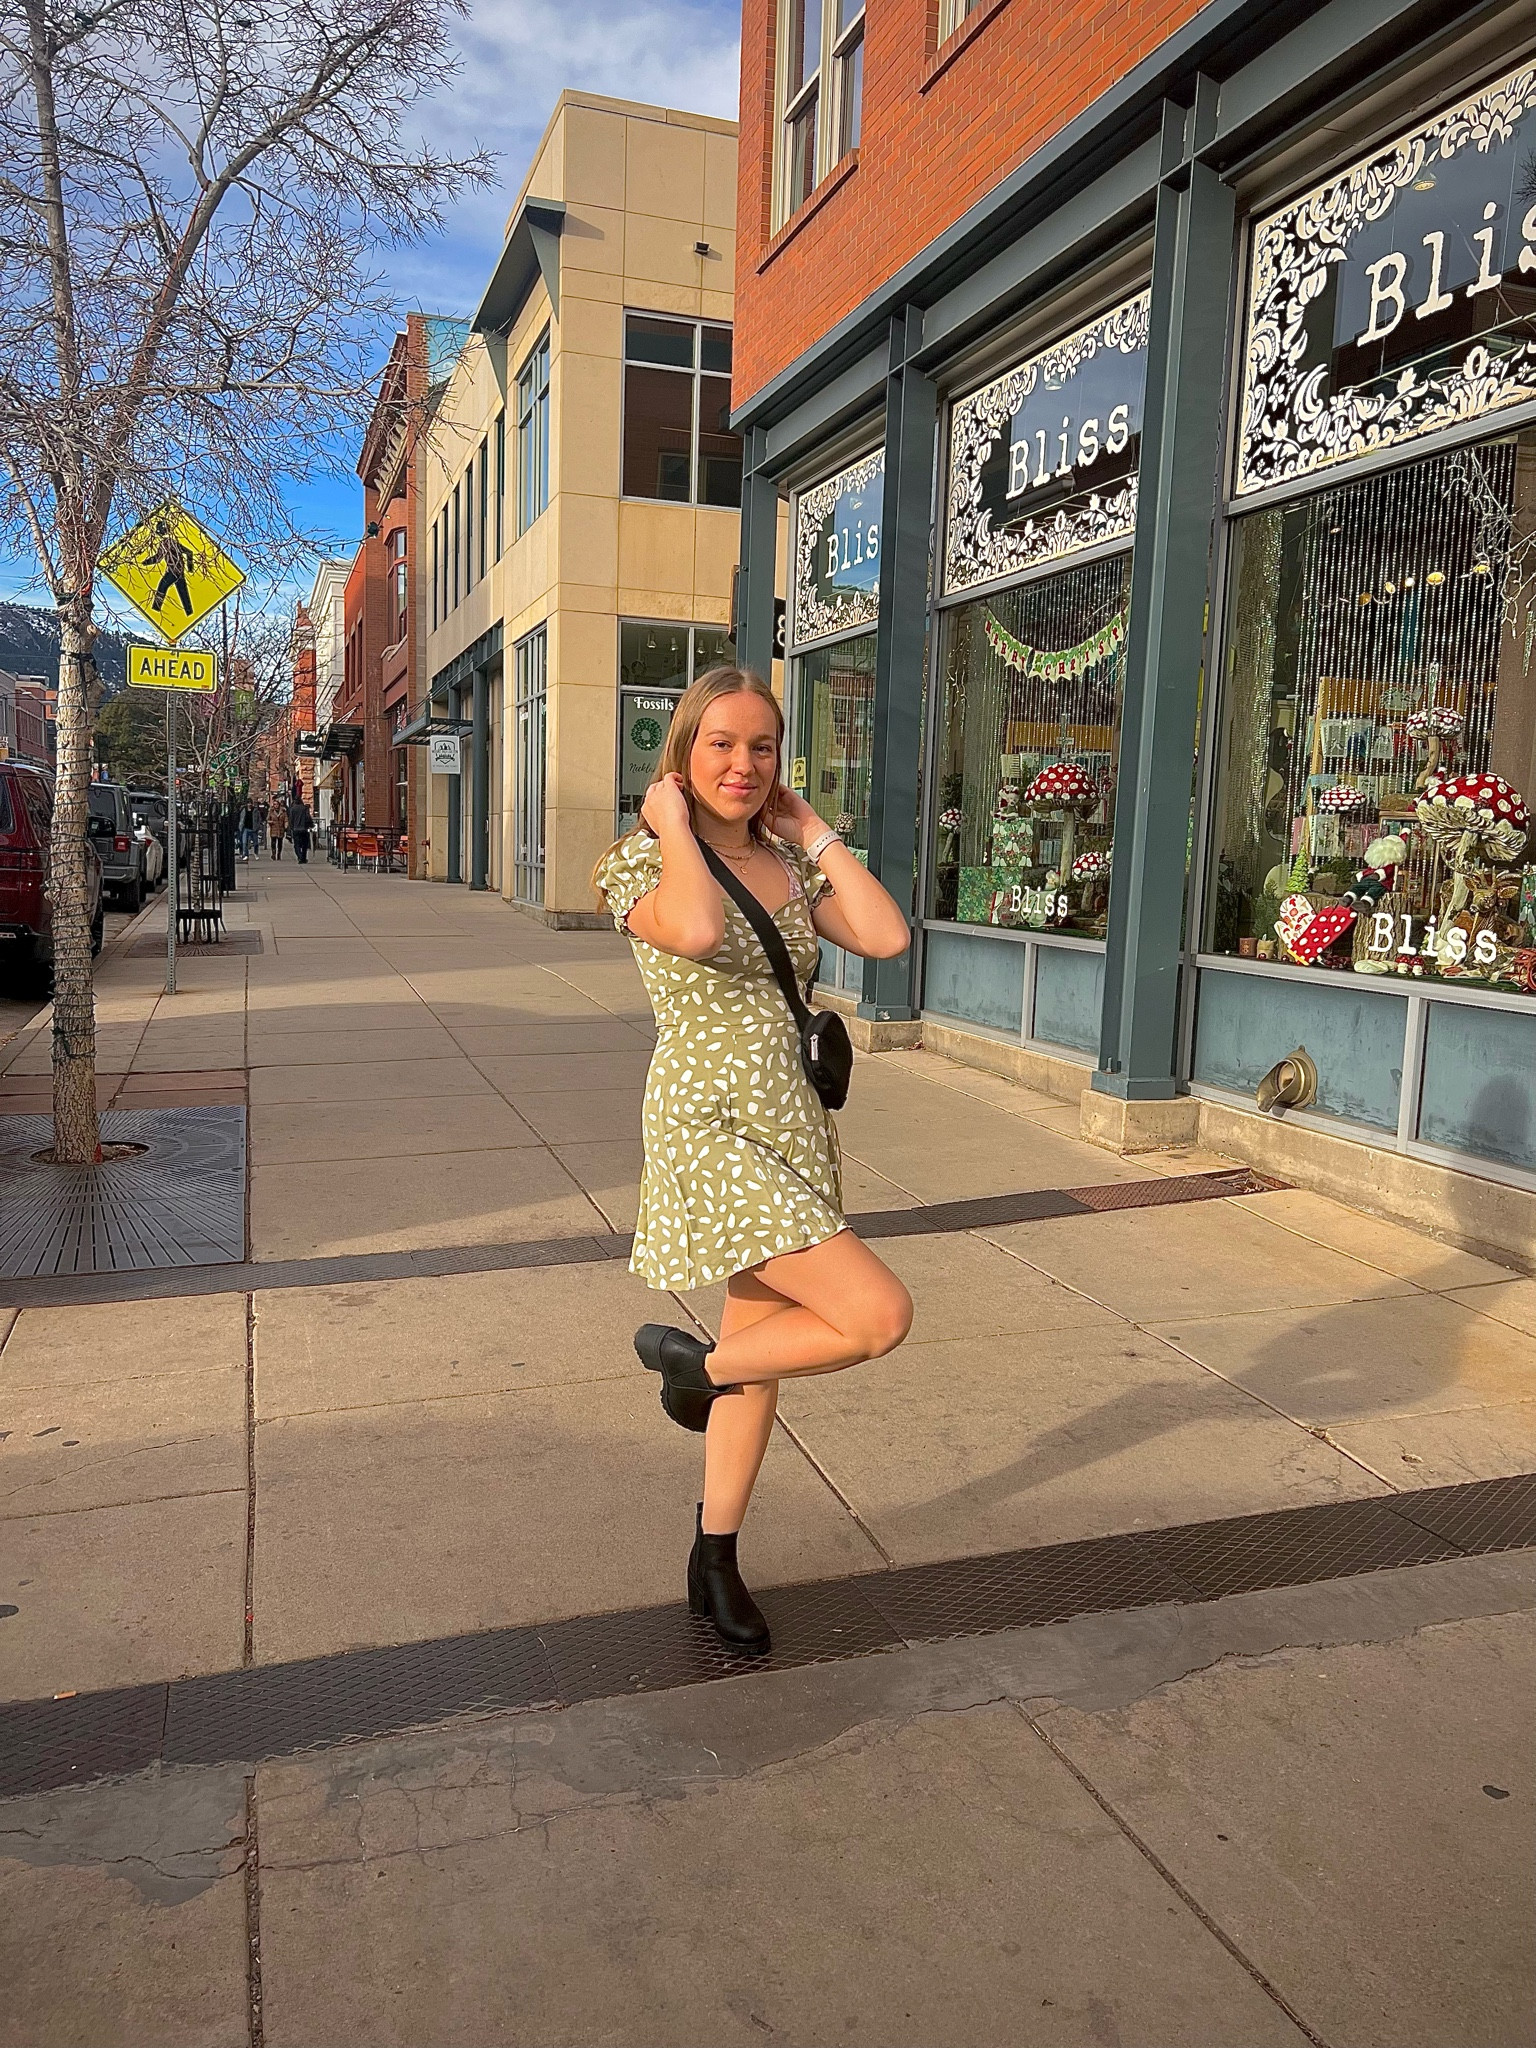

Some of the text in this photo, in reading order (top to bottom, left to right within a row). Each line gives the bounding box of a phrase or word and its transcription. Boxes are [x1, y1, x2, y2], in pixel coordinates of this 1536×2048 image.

[1005, 403, 1129, 501] Bliss
[824, 519, 879, 579] Blis
[139, 657, 205, 681] AHEAD
[985, 620, 1026, 669] MERRY
[633, 696, 674, 711] Fossils
[1009, 885, 1069, 918] Bliss
[1367, 912, 1498, 965] Bliss
